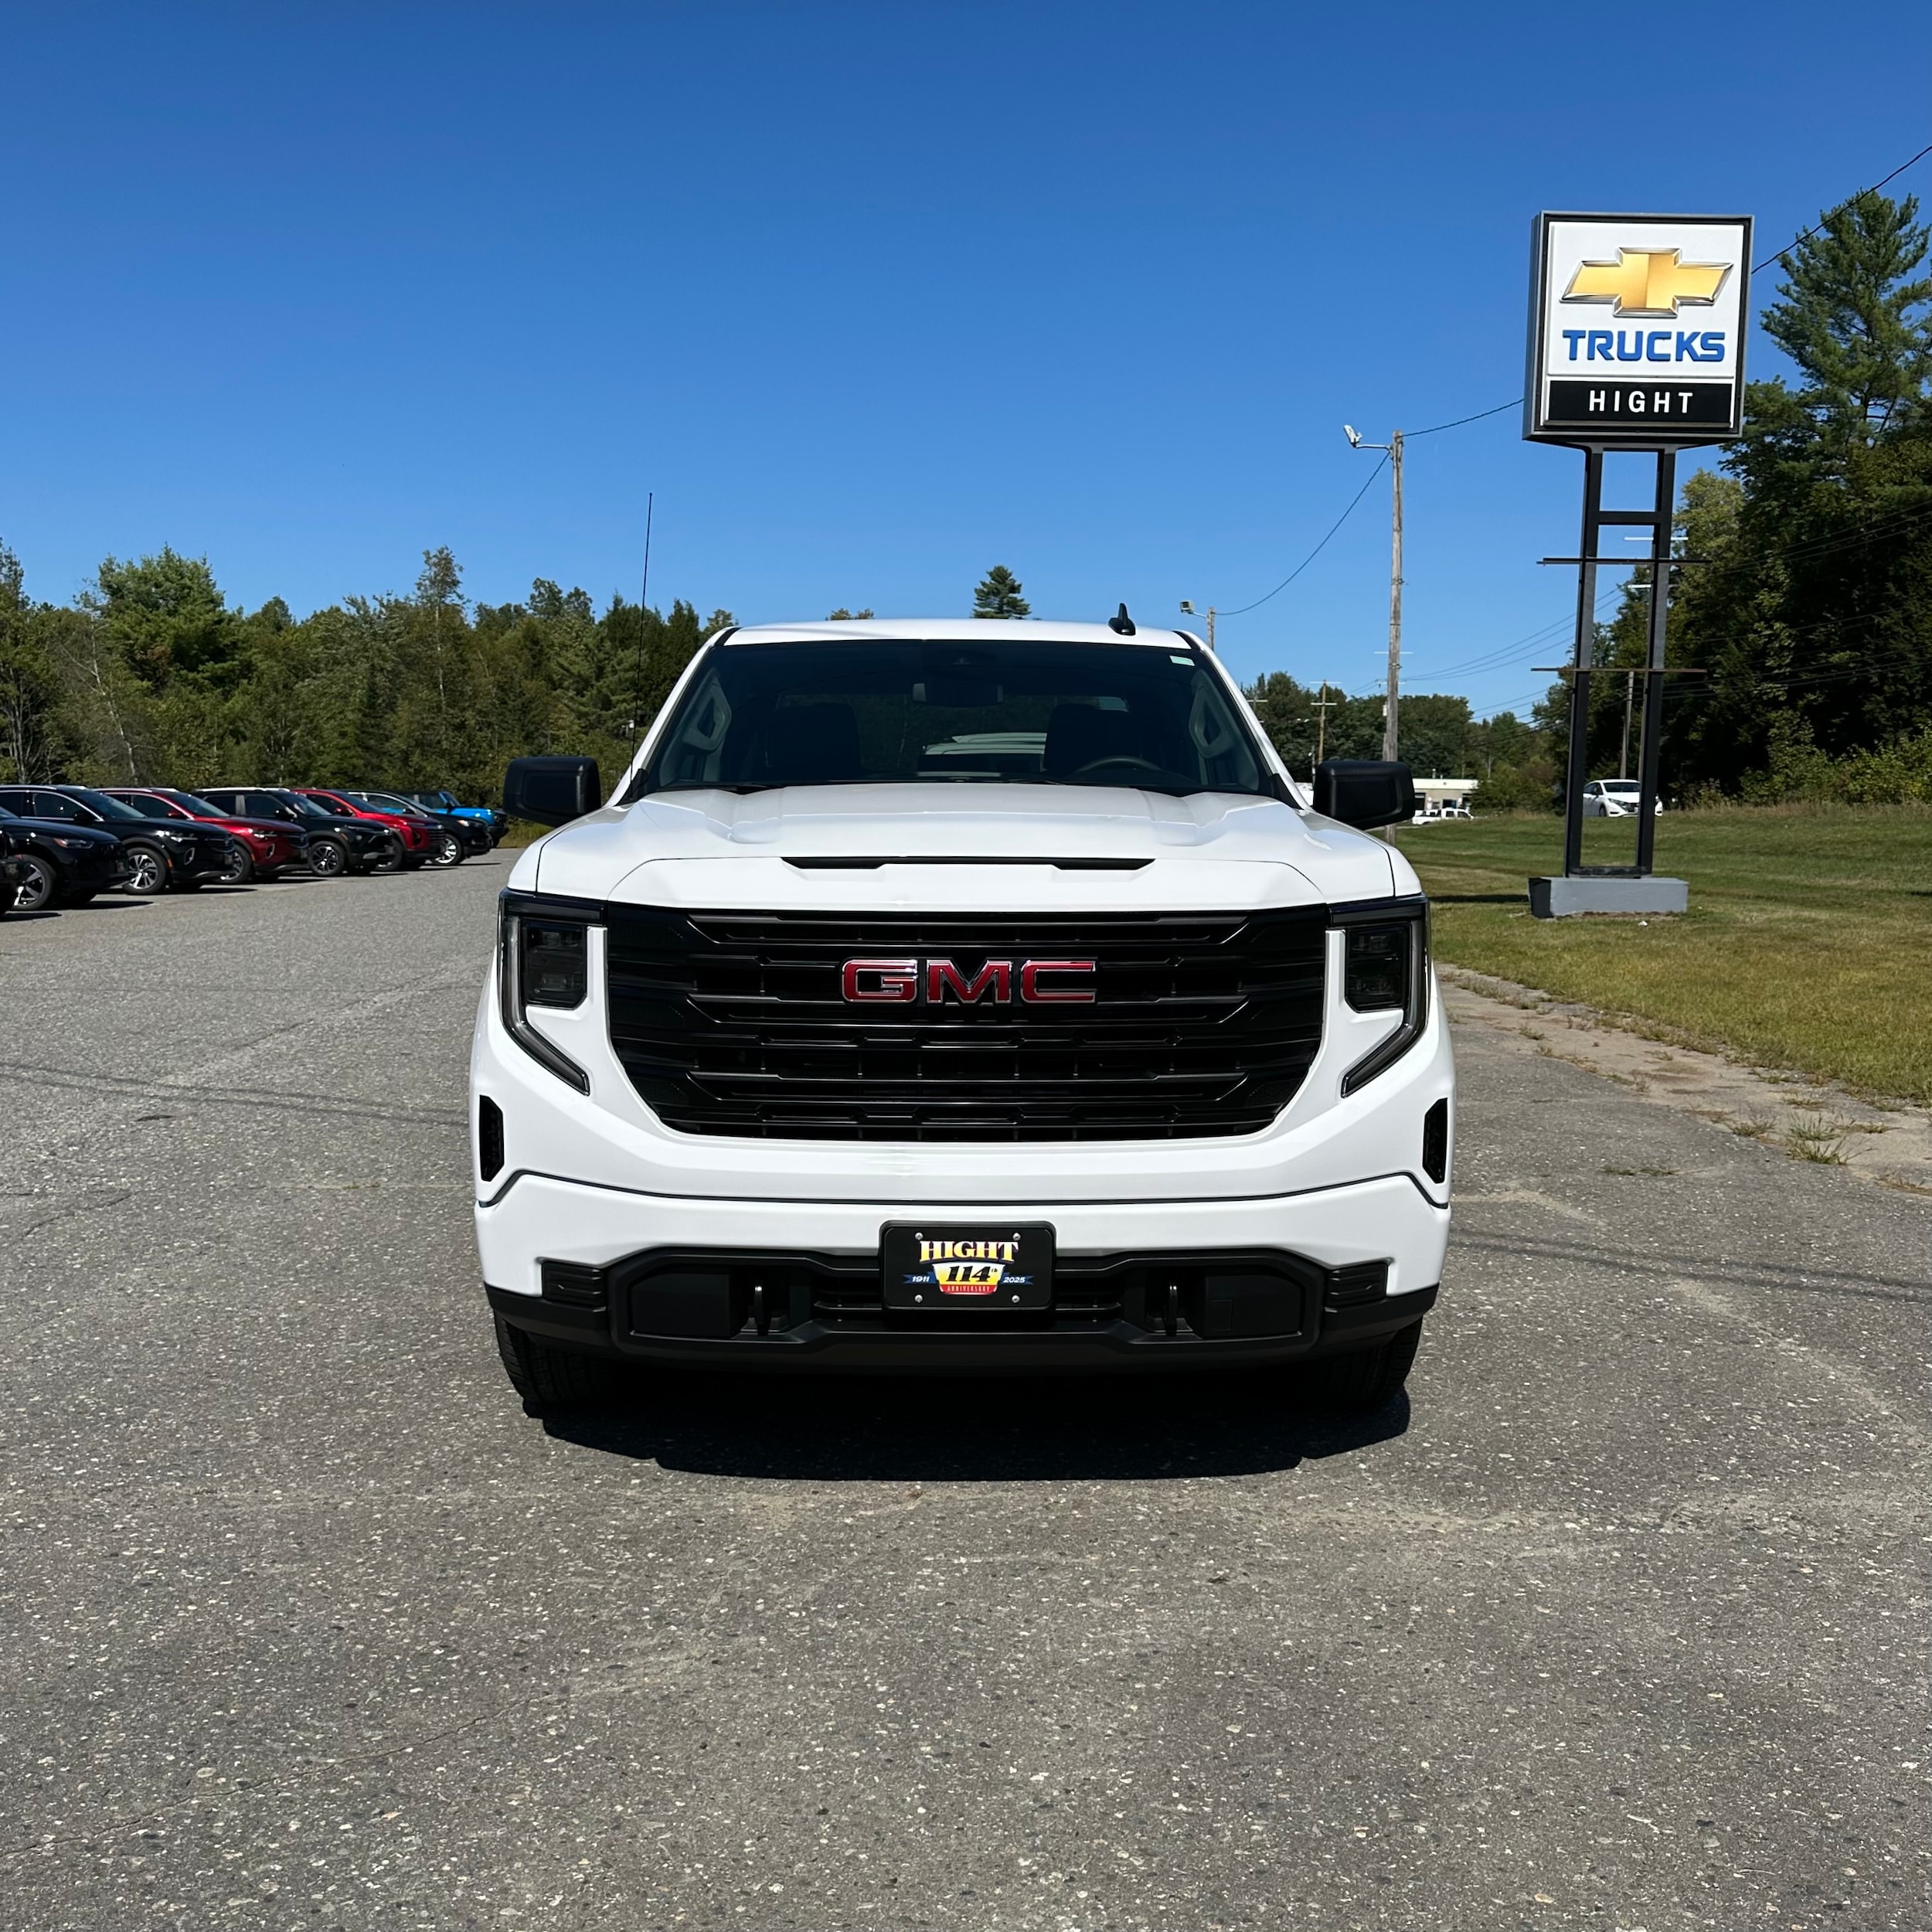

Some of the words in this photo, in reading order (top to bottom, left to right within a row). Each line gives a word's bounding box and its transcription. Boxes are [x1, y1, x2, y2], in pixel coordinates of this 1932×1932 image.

[1562, 329, 1726, 362] TRUCKS
[1589, 389, 1692, 413] HIGHT
[842, 959, 1096, 1004] GMC
[919, 1240, 1019, 1263] HIGHT
